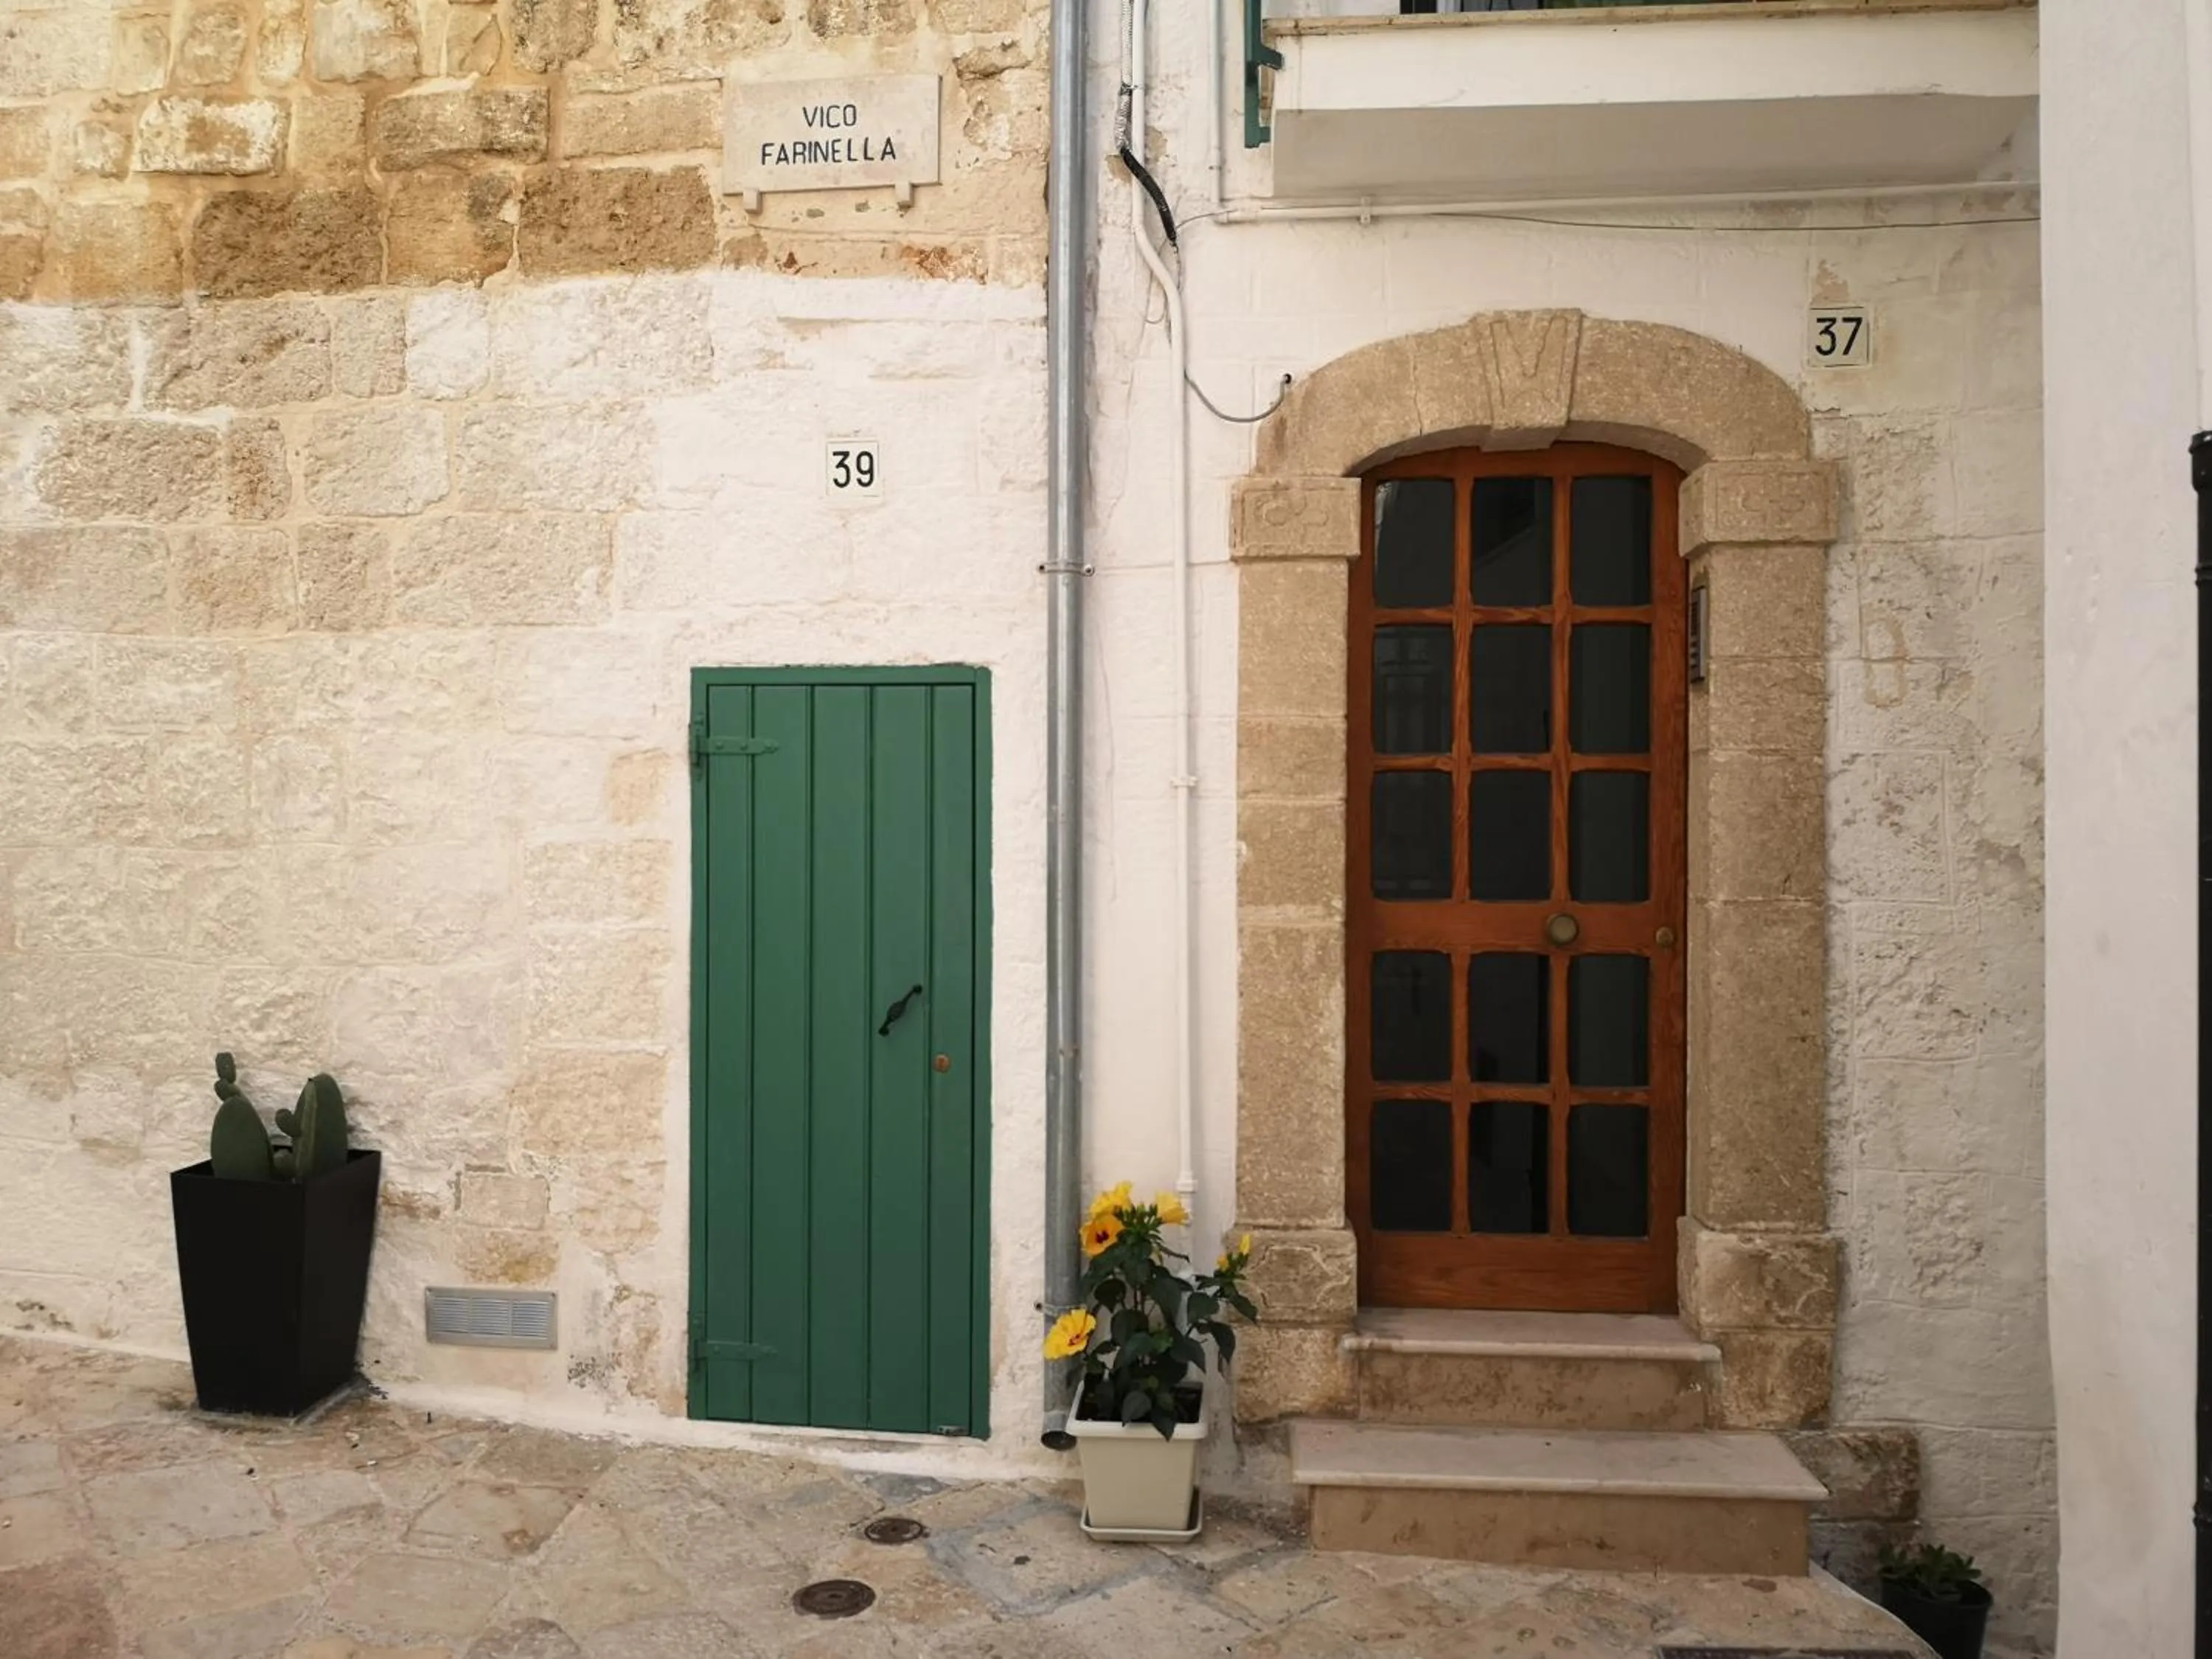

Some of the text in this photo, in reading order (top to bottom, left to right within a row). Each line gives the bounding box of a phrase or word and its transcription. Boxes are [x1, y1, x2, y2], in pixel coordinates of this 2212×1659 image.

[802, 104, 858, 128] VICO
[761, 136, 897, 165] FARINELLA
[1815, 316, 1863, 356] 37
[832, 450, 874, 488] 39
